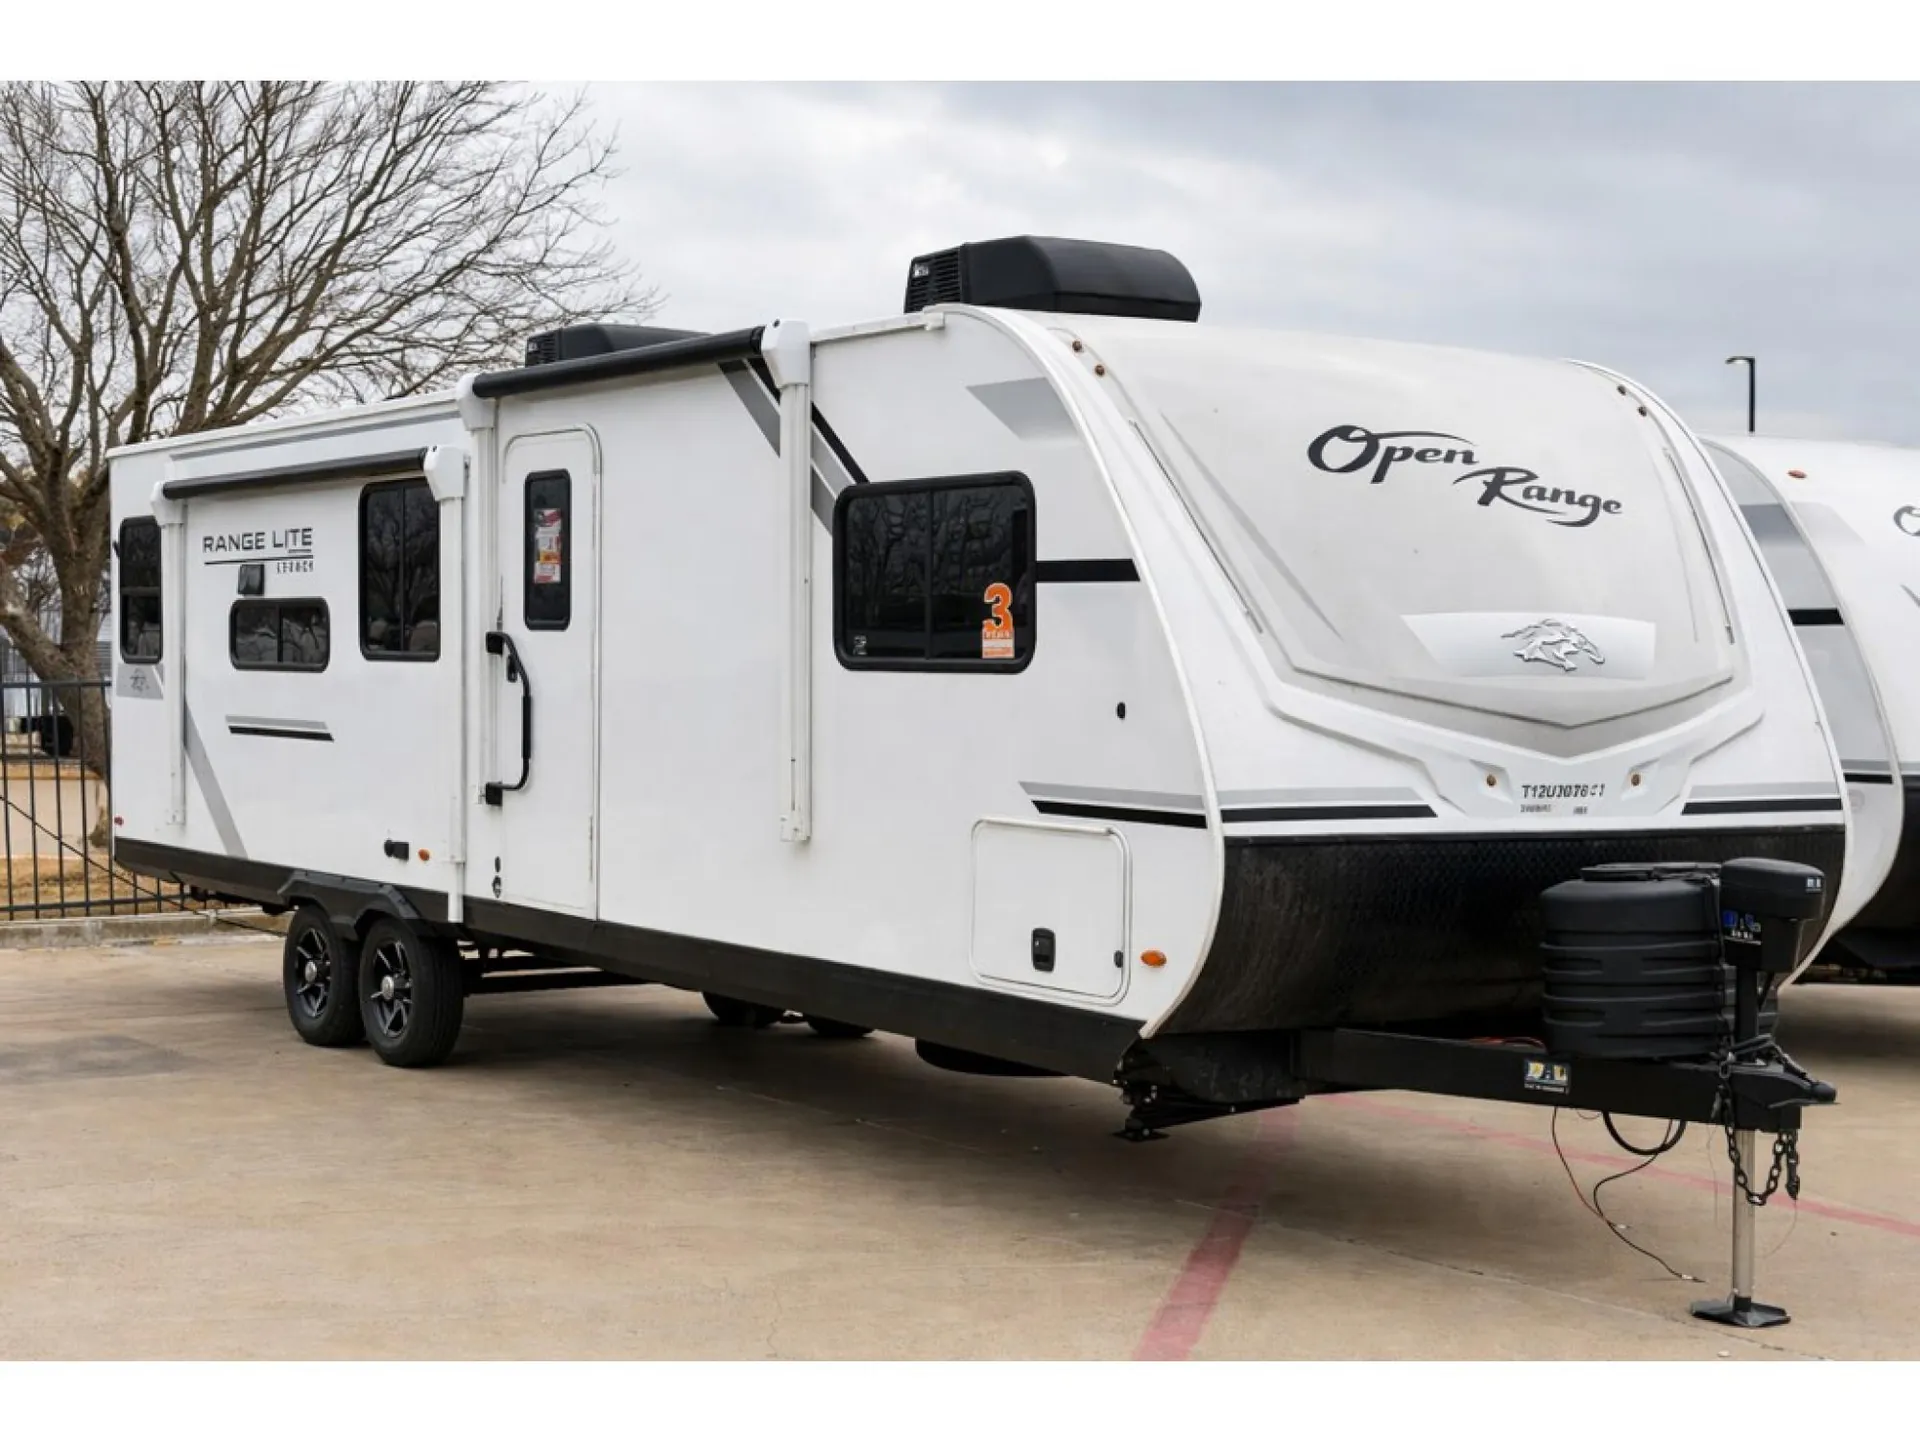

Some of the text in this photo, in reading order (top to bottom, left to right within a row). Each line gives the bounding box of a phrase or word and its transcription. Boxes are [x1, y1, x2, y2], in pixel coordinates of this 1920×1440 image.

[1307, 424, 1479, 484] Open
[1452, 466, 1623, 527] Range
[202, 527, 313, 553] RANGE LITE
[982, 582, 1013, 633] 3
